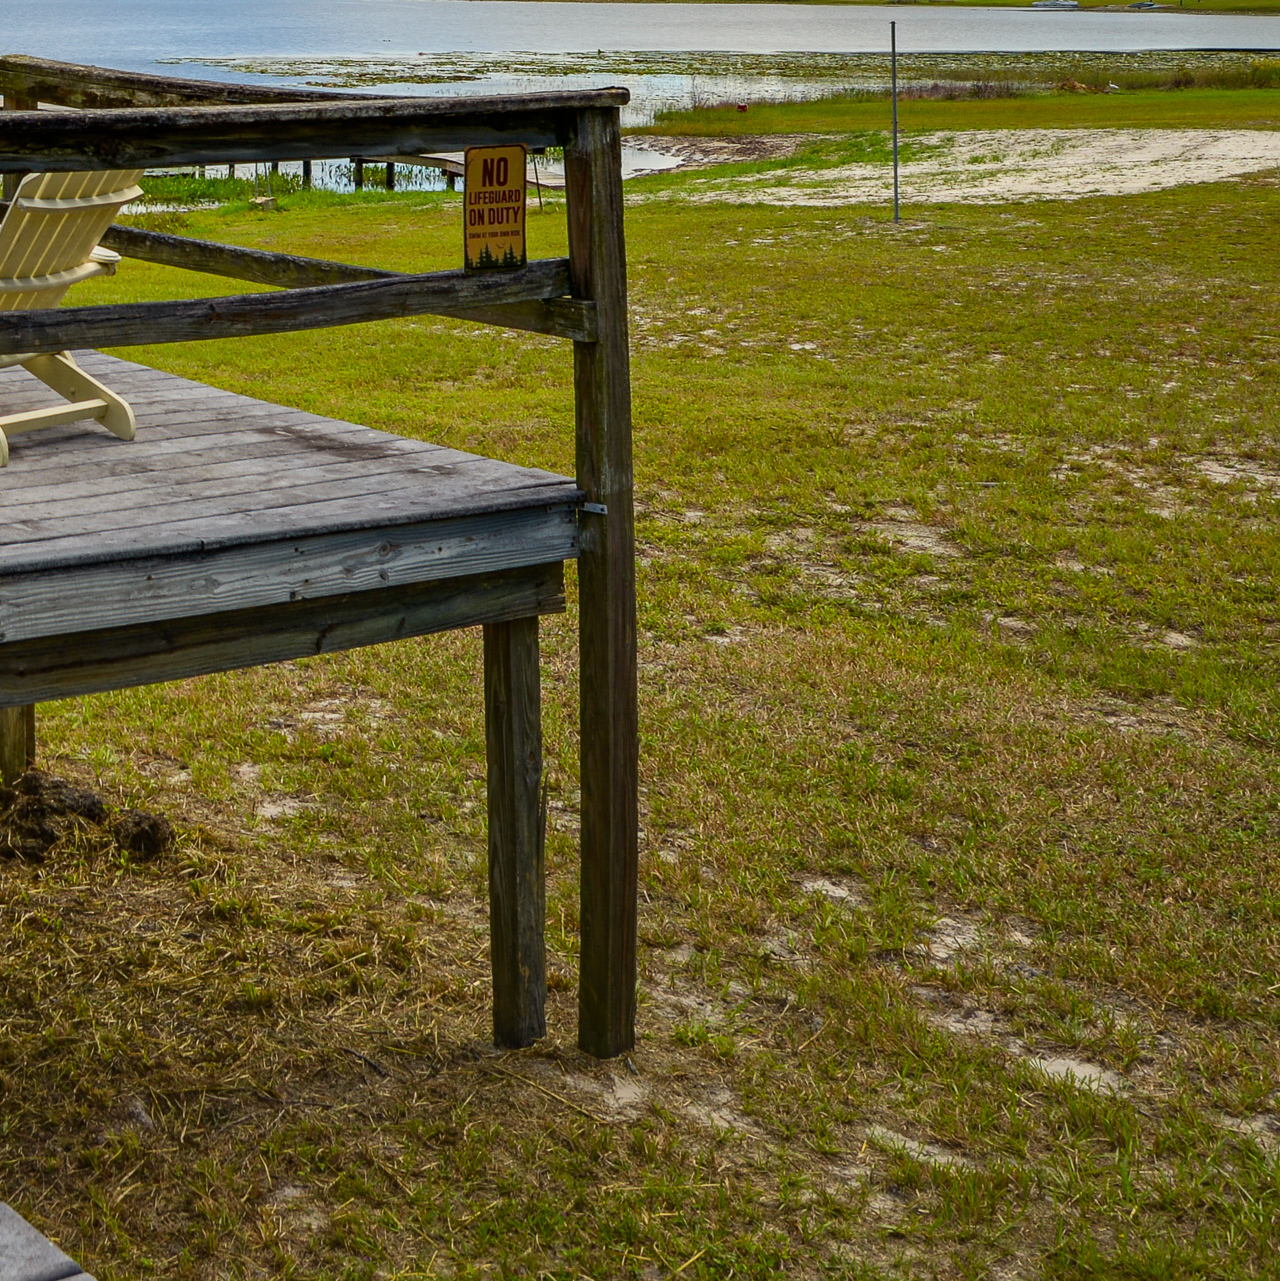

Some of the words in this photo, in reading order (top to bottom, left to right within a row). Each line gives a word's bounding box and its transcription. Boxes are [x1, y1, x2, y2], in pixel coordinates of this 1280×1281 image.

[482, 157, 508, 187] NO
[469, 189, 520, 205] LIFEGUARD
[469, 208, 485, 226] ON
[488, 206, 520, 225] DUTY
